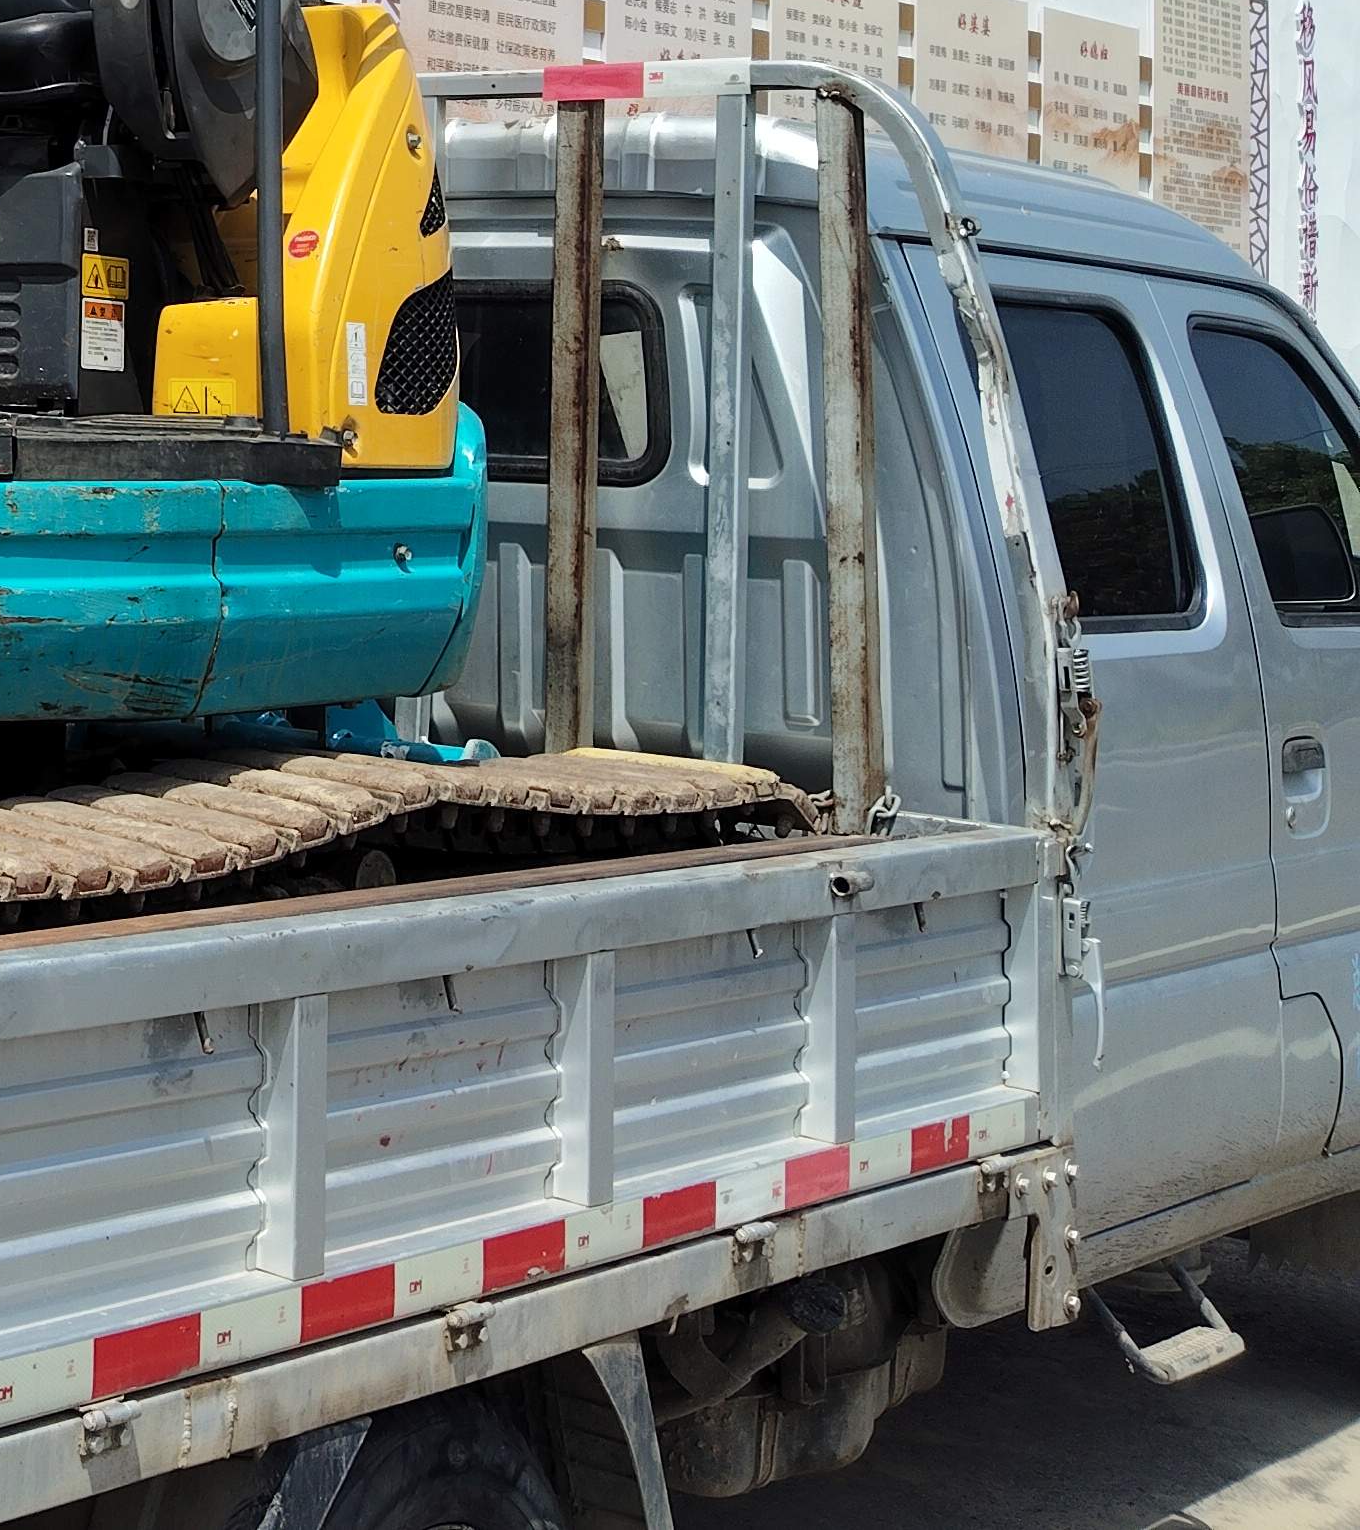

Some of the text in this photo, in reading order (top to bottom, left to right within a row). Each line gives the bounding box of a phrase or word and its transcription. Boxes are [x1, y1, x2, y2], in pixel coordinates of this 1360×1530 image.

[1299, 0, 1319, 325] 移风易俗谱新
